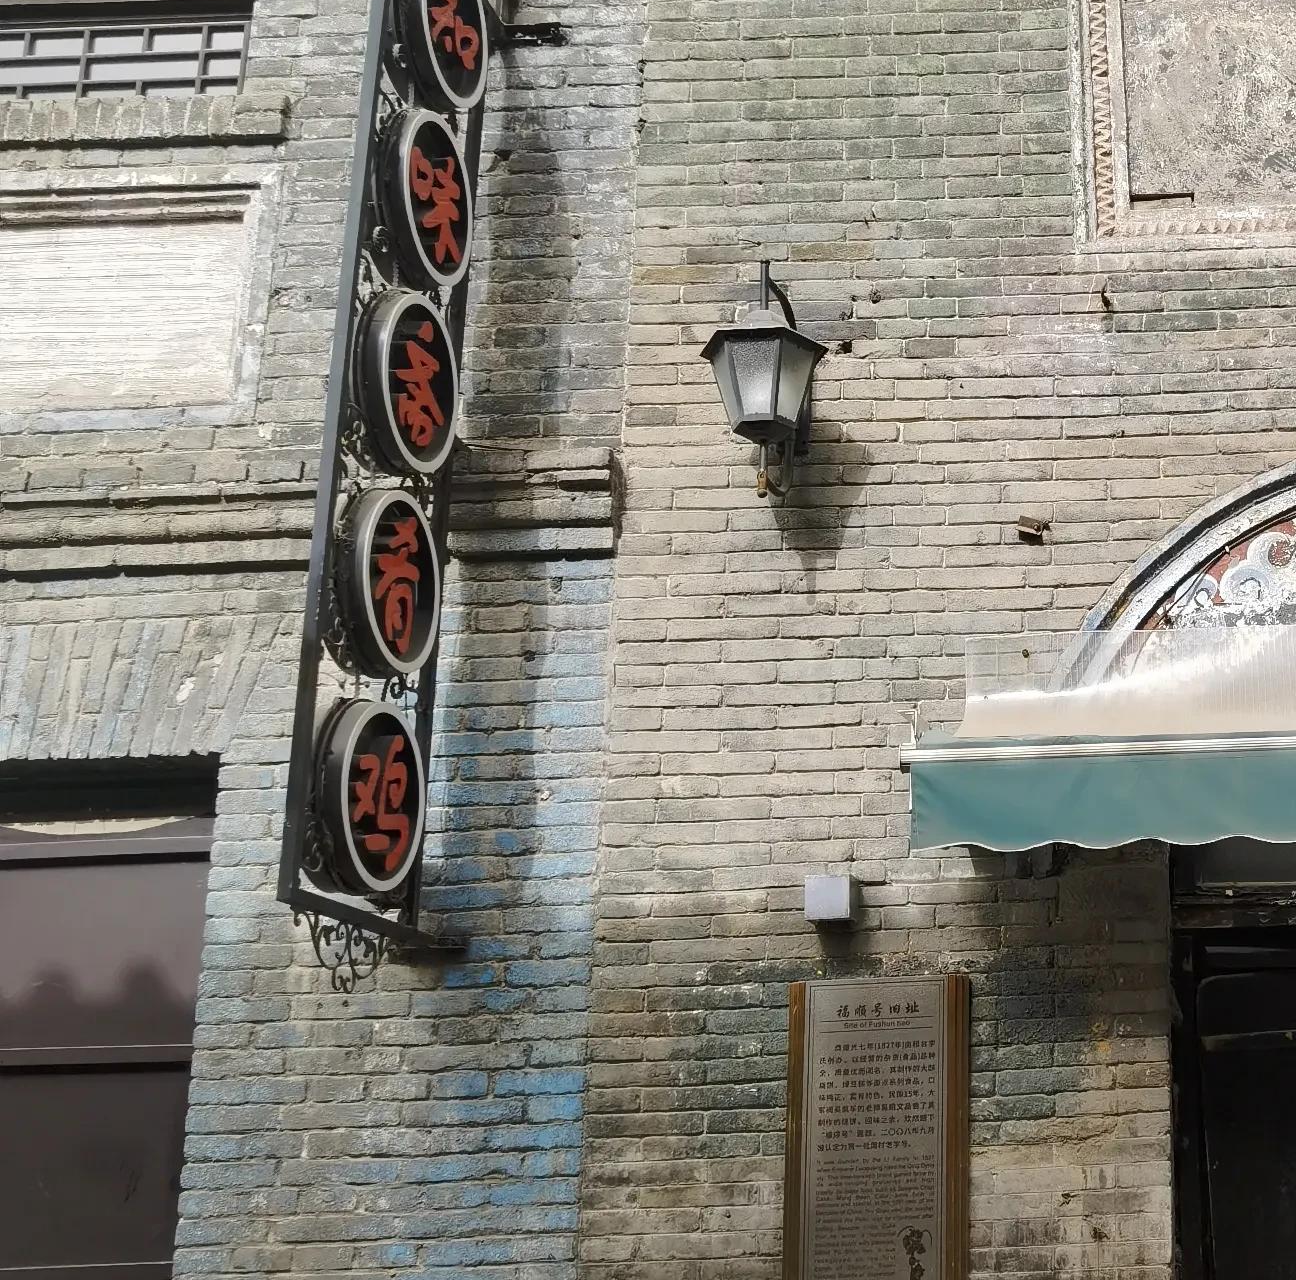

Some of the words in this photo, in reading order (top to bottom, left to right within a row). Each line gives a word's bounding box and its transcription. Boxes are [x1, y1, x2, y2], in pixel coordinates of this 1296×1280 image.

[836, 1000, 920, 1018] 福顺号旧址
